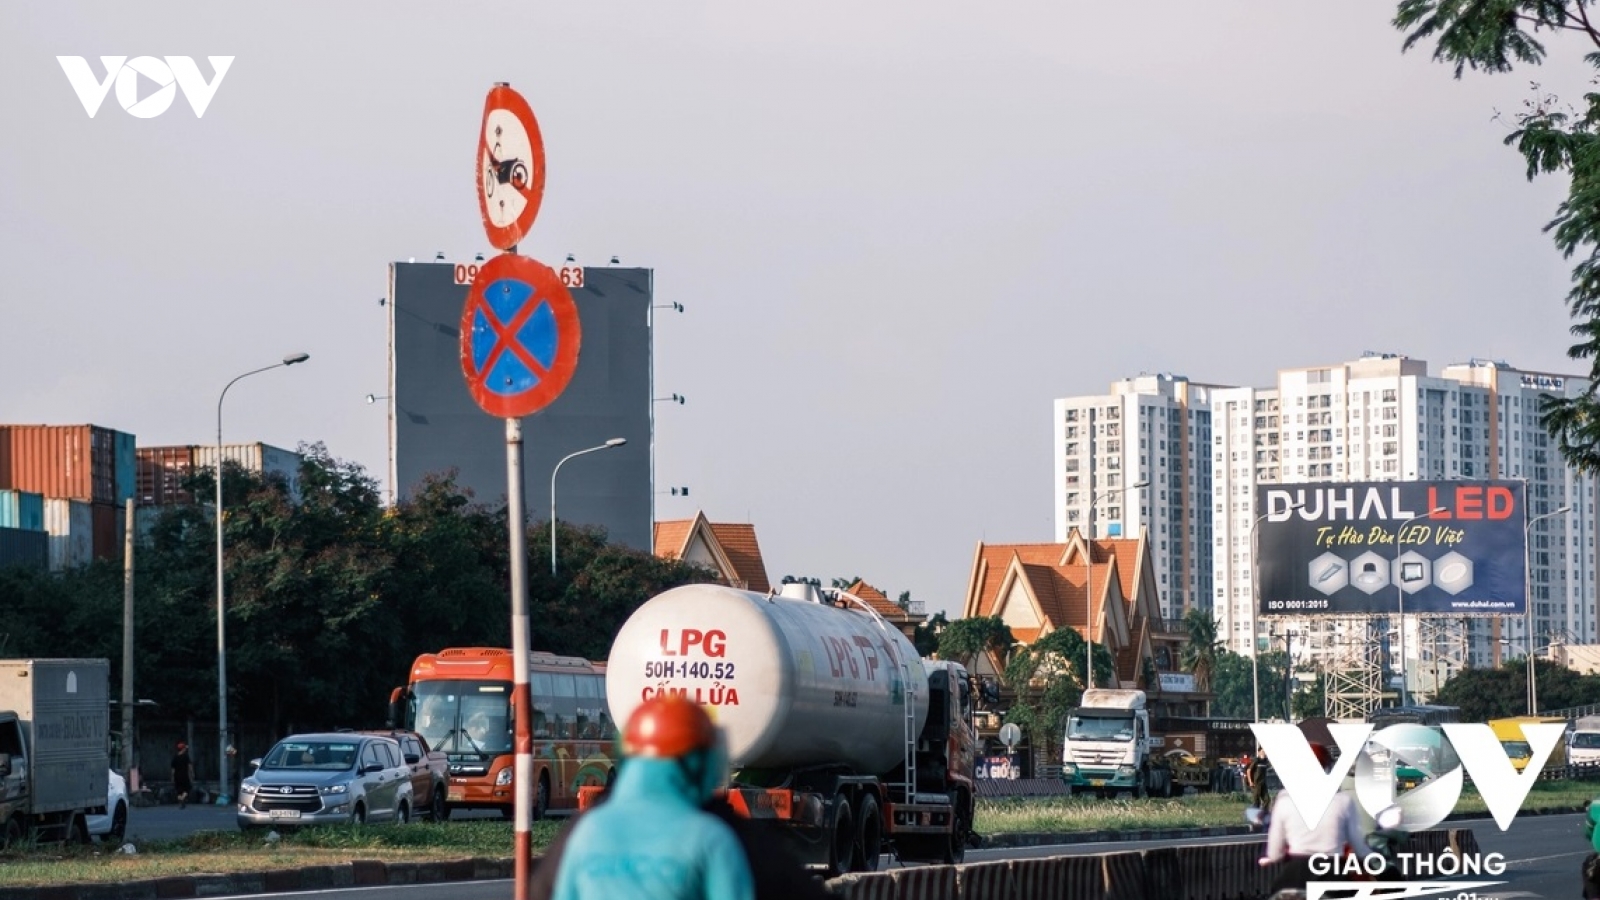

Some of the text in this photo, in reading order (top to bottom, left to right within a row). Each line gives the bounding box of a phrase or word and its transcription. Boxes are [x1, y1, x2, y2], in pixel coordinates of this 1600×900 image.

[1267, 486, 1514, 522] DUHAL LED
[1316, 525, 1465, 548] Tự Hào Đèn LED Việt
[1268, 600, 1328, 609] ISO 9001:2015
[1451, 600, 1515, 608] www.duhal.com.vn
[660, 628, 726, 658] LPG
[645, 660, 735, 679] 50H-140.52
[820, 635, 860, 680] LPG
[695, 681, 739, 706] LỬA
